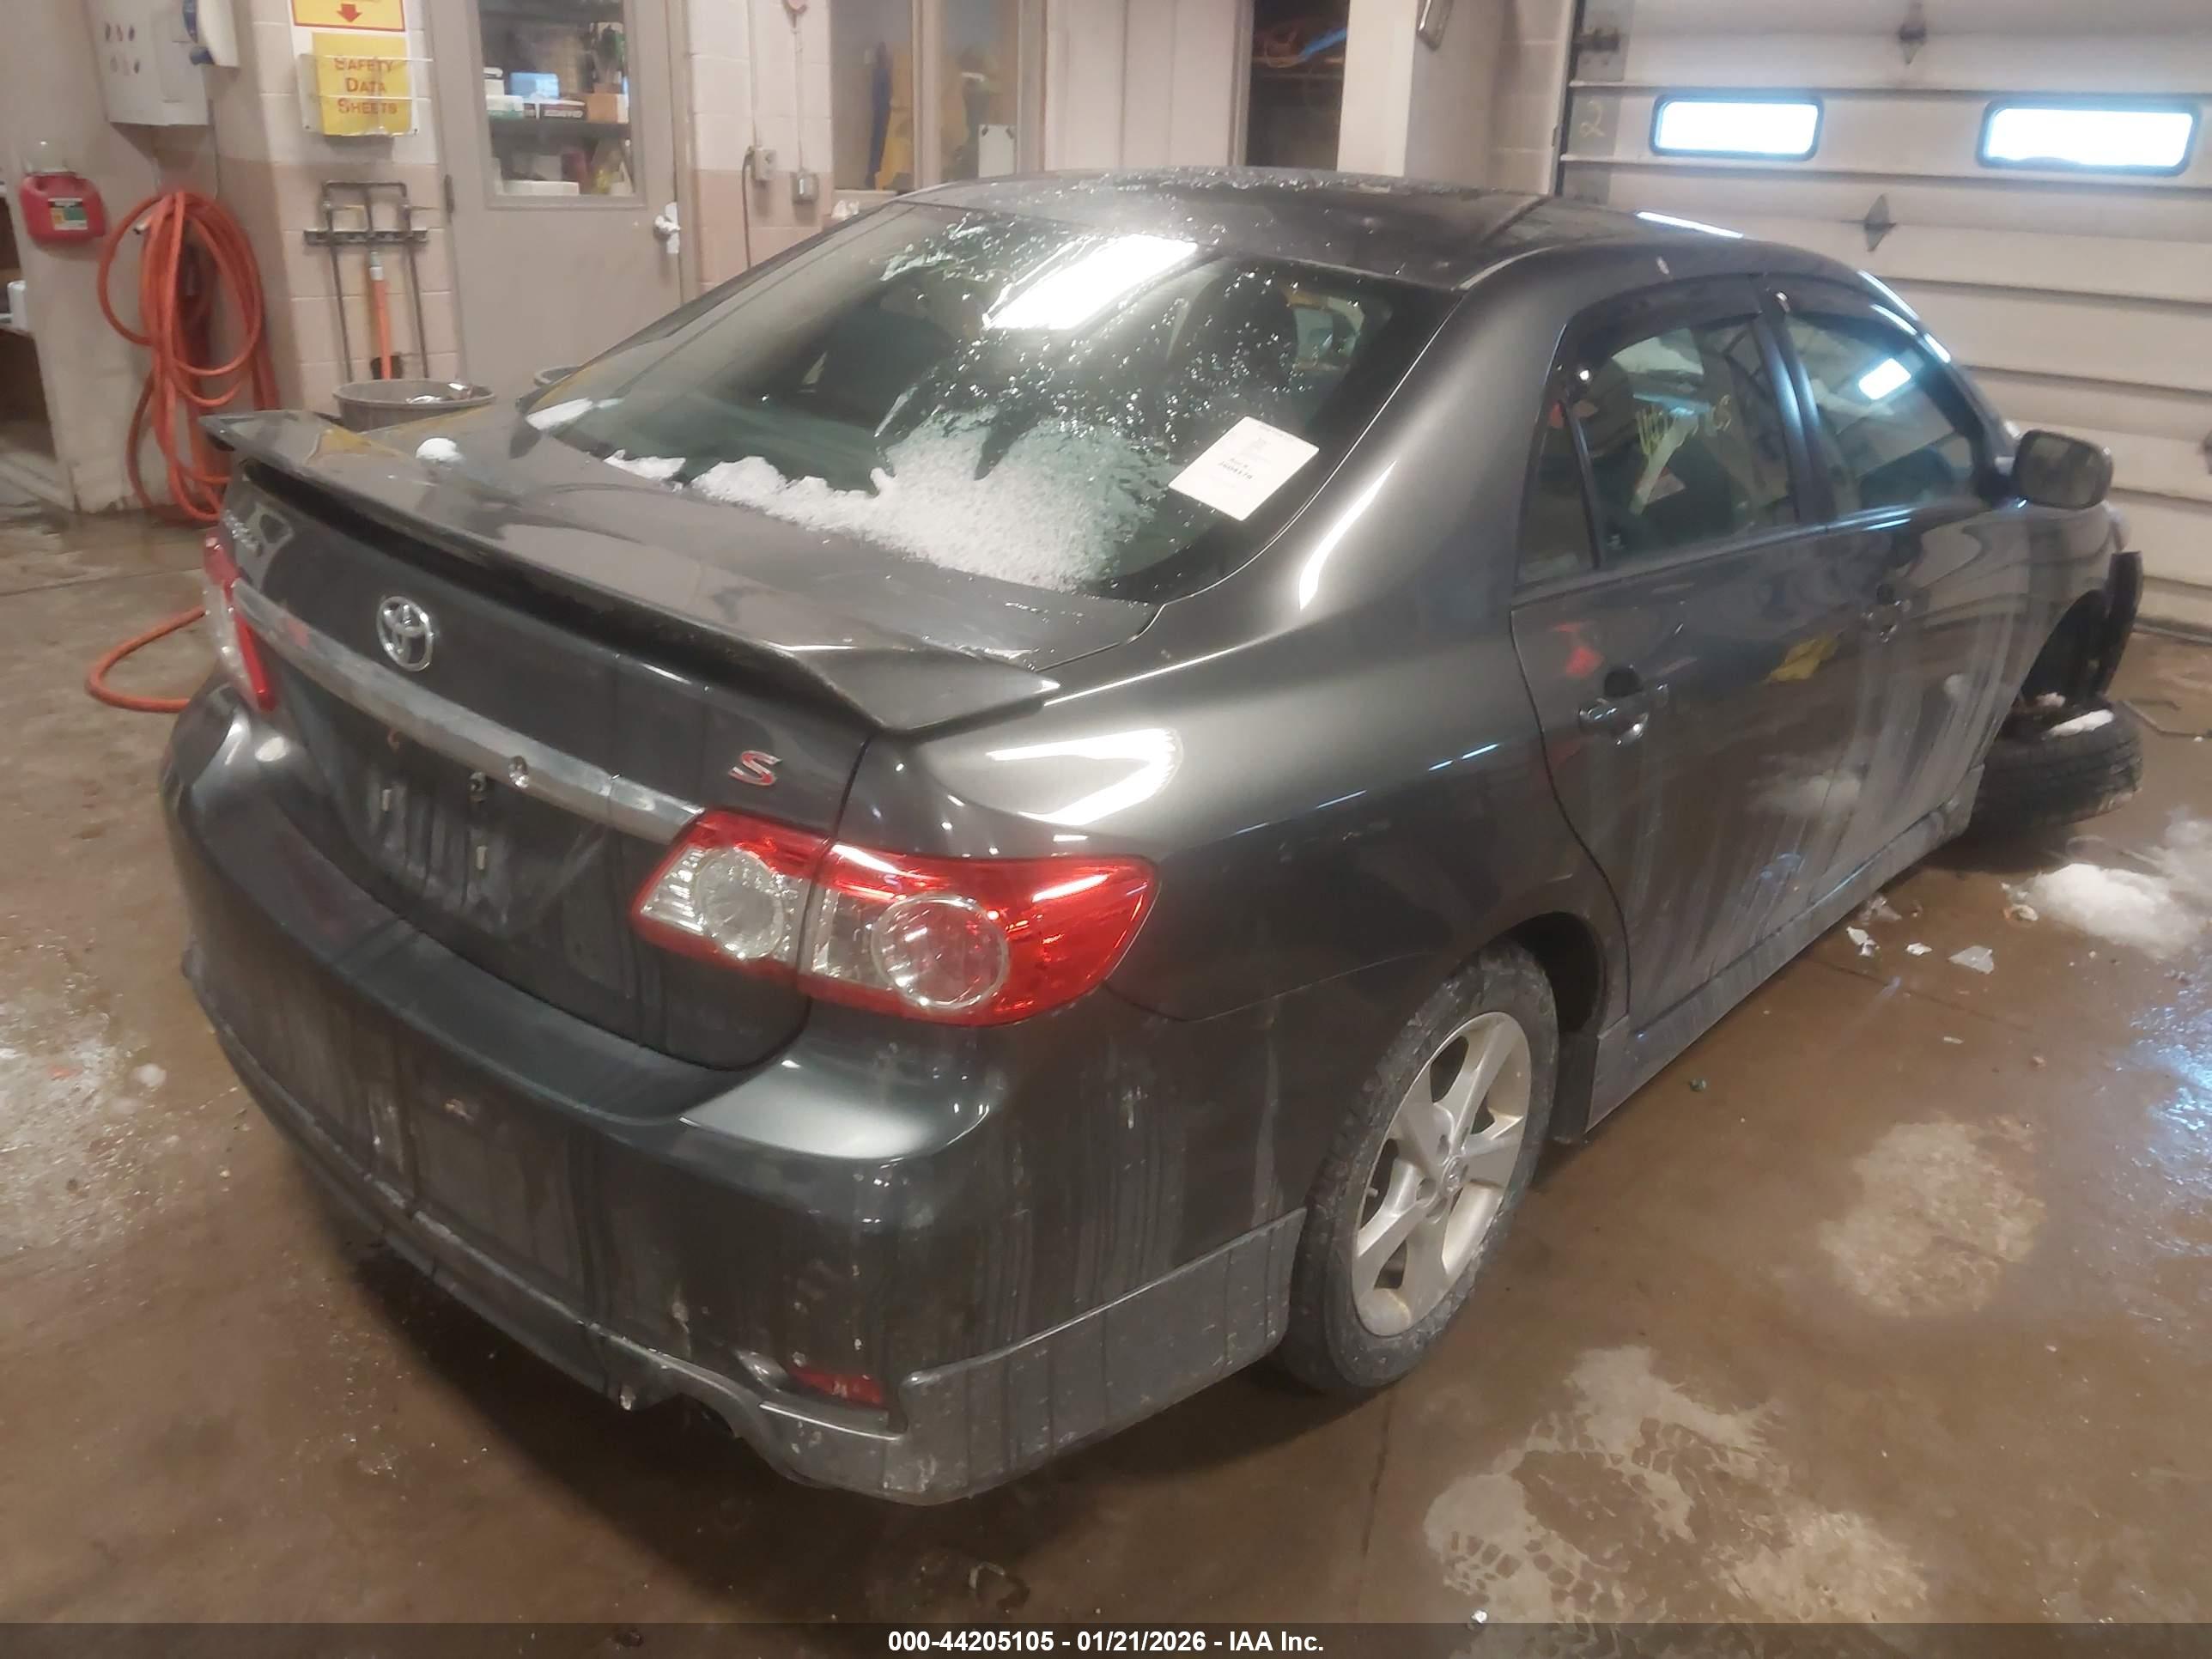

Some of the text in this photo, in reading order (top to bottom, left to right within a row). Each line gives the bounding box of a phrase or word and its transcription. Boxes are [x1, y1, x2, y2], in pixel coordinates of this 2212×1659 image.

[334, 57, 393, 72] SAFETY
[345, 77, 386, 93] DATA
[337, 97, 398, 114] SHEETS
[728, 750, 782, 787] S
